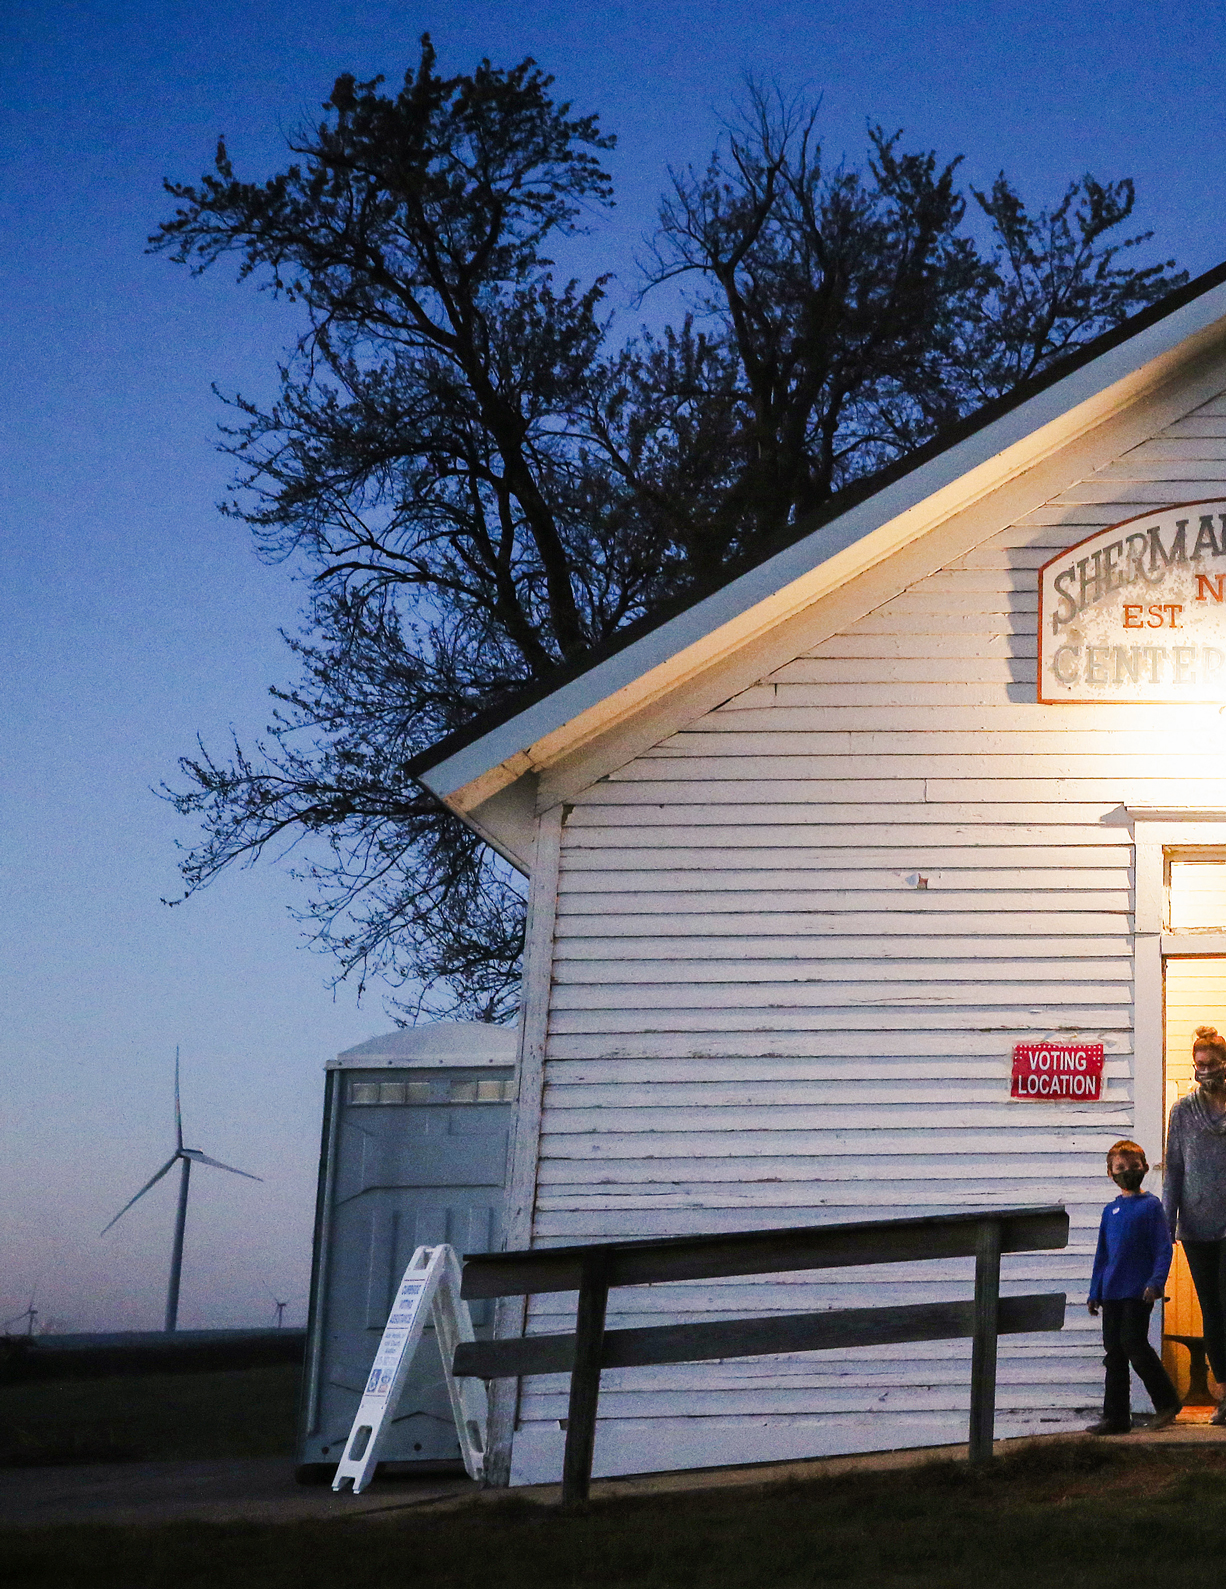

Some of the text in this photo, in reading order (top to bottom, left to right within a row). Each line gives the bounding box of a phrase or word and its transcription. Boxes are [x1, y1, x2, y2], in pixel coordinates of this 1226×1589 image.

[1122, 604, 1184, 629] EST.
[1028, 1051, 1087, 1071] VOTING
[1018, 1074, 1096, 1095] LOCATION
